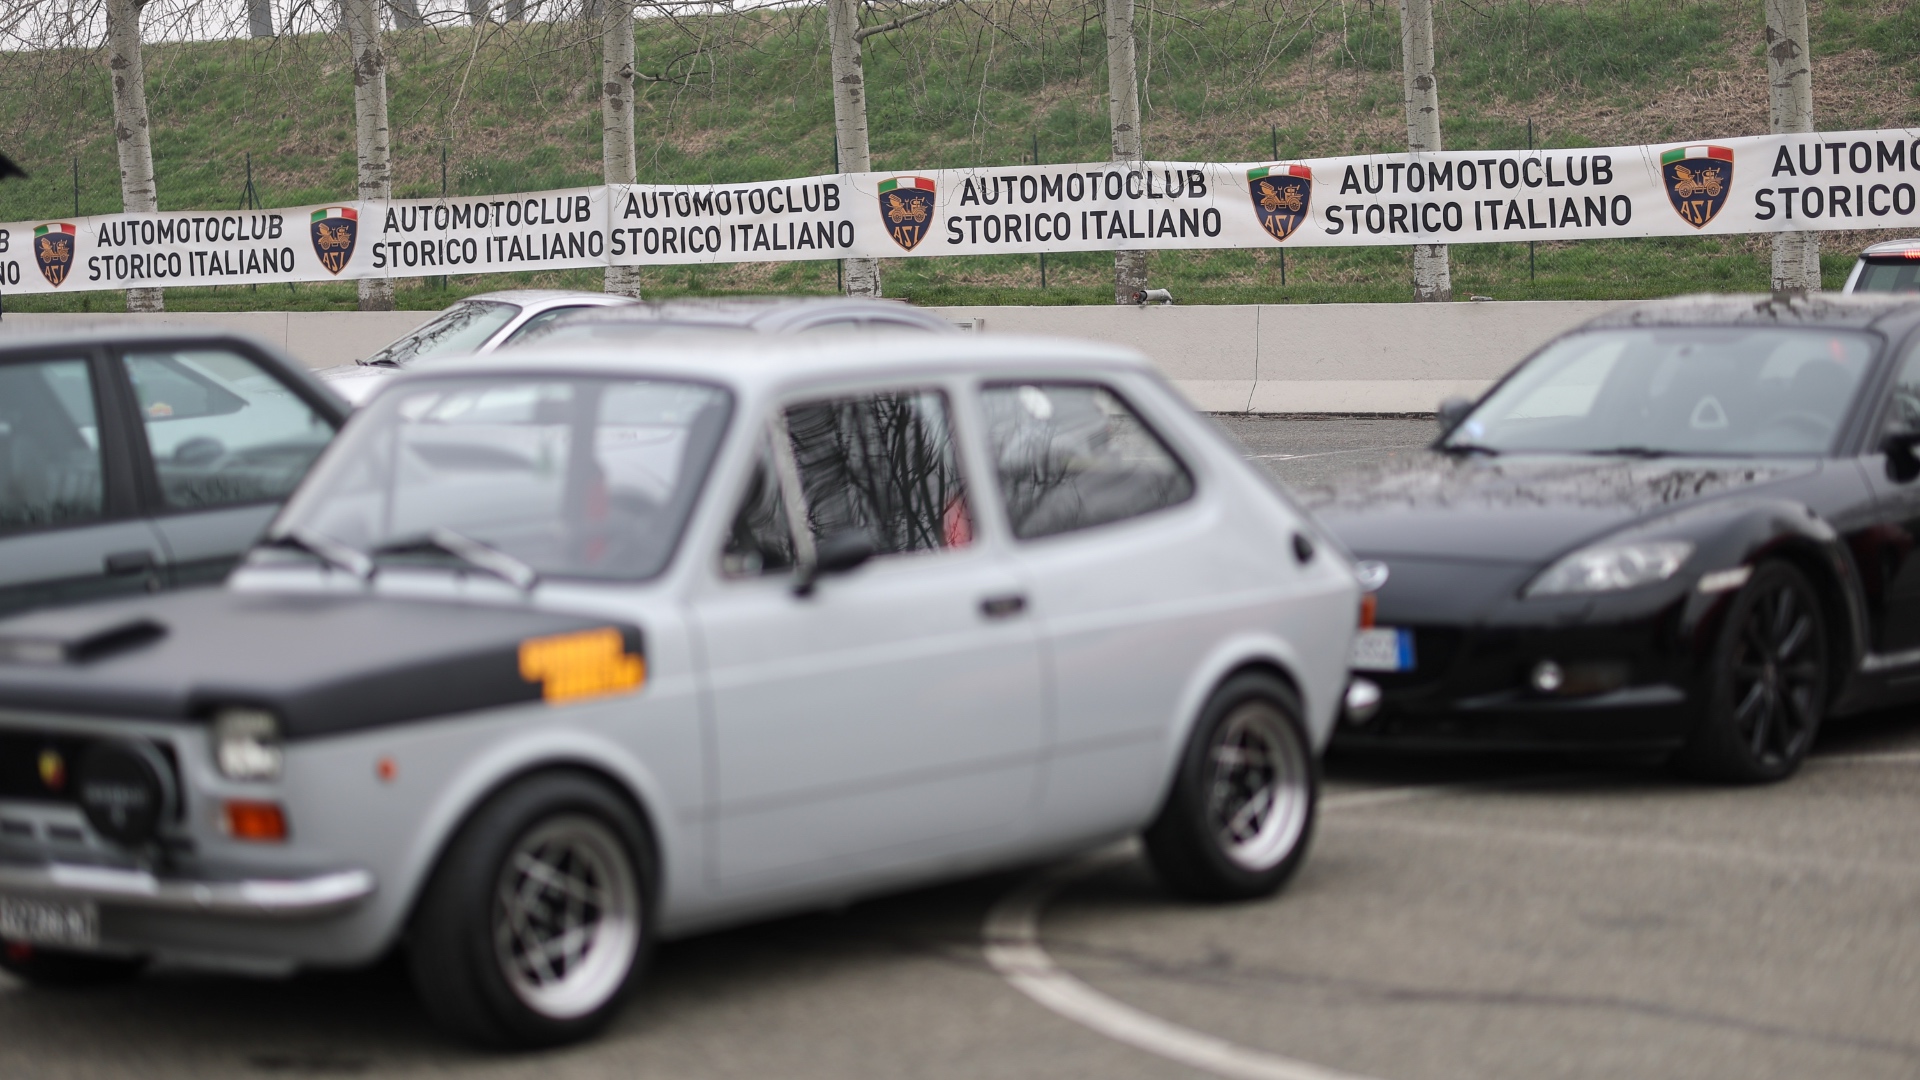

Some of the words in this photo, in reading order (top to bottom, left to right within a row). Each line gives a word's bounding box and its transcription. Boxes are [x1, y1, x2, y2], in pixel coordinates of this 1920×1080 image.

[960, 169, 1207, 206] AUTOMOTOCLUB
[1339, 154, 1613, 195] AUTOMOTOCLUB
[384, 195, 592, 234] AUTOMOTOCLUB
[624, 183, 840, 219] AUTOMOTOCLUB
[1324, 202, 1463, 235] STORICO
[1474, 194, 1632, 232] ITALIANO
[1679, 199, 1714, 224] ASI
[1754, 182, 1916, 221] STORICO
[97, 214, 284, 248] AUTOMOTOCLUB
[610, 225, 722, 256] STORICO
[729, 215, 855, 252] ITALIANO
[893, 225, 921, 248] ASI
[947, 211, 1071, 245] STORICO
[1081, 206, 1222, 242] ITALIANO
[1264, 214, 1296, 237] ASI
[88, 251, 182, 281] STORICO
[188, 245, 296, 277] ITALIANO
[372, 230, 478, 269] STORICO
[486, 224, 604, 263] ITALIANO
